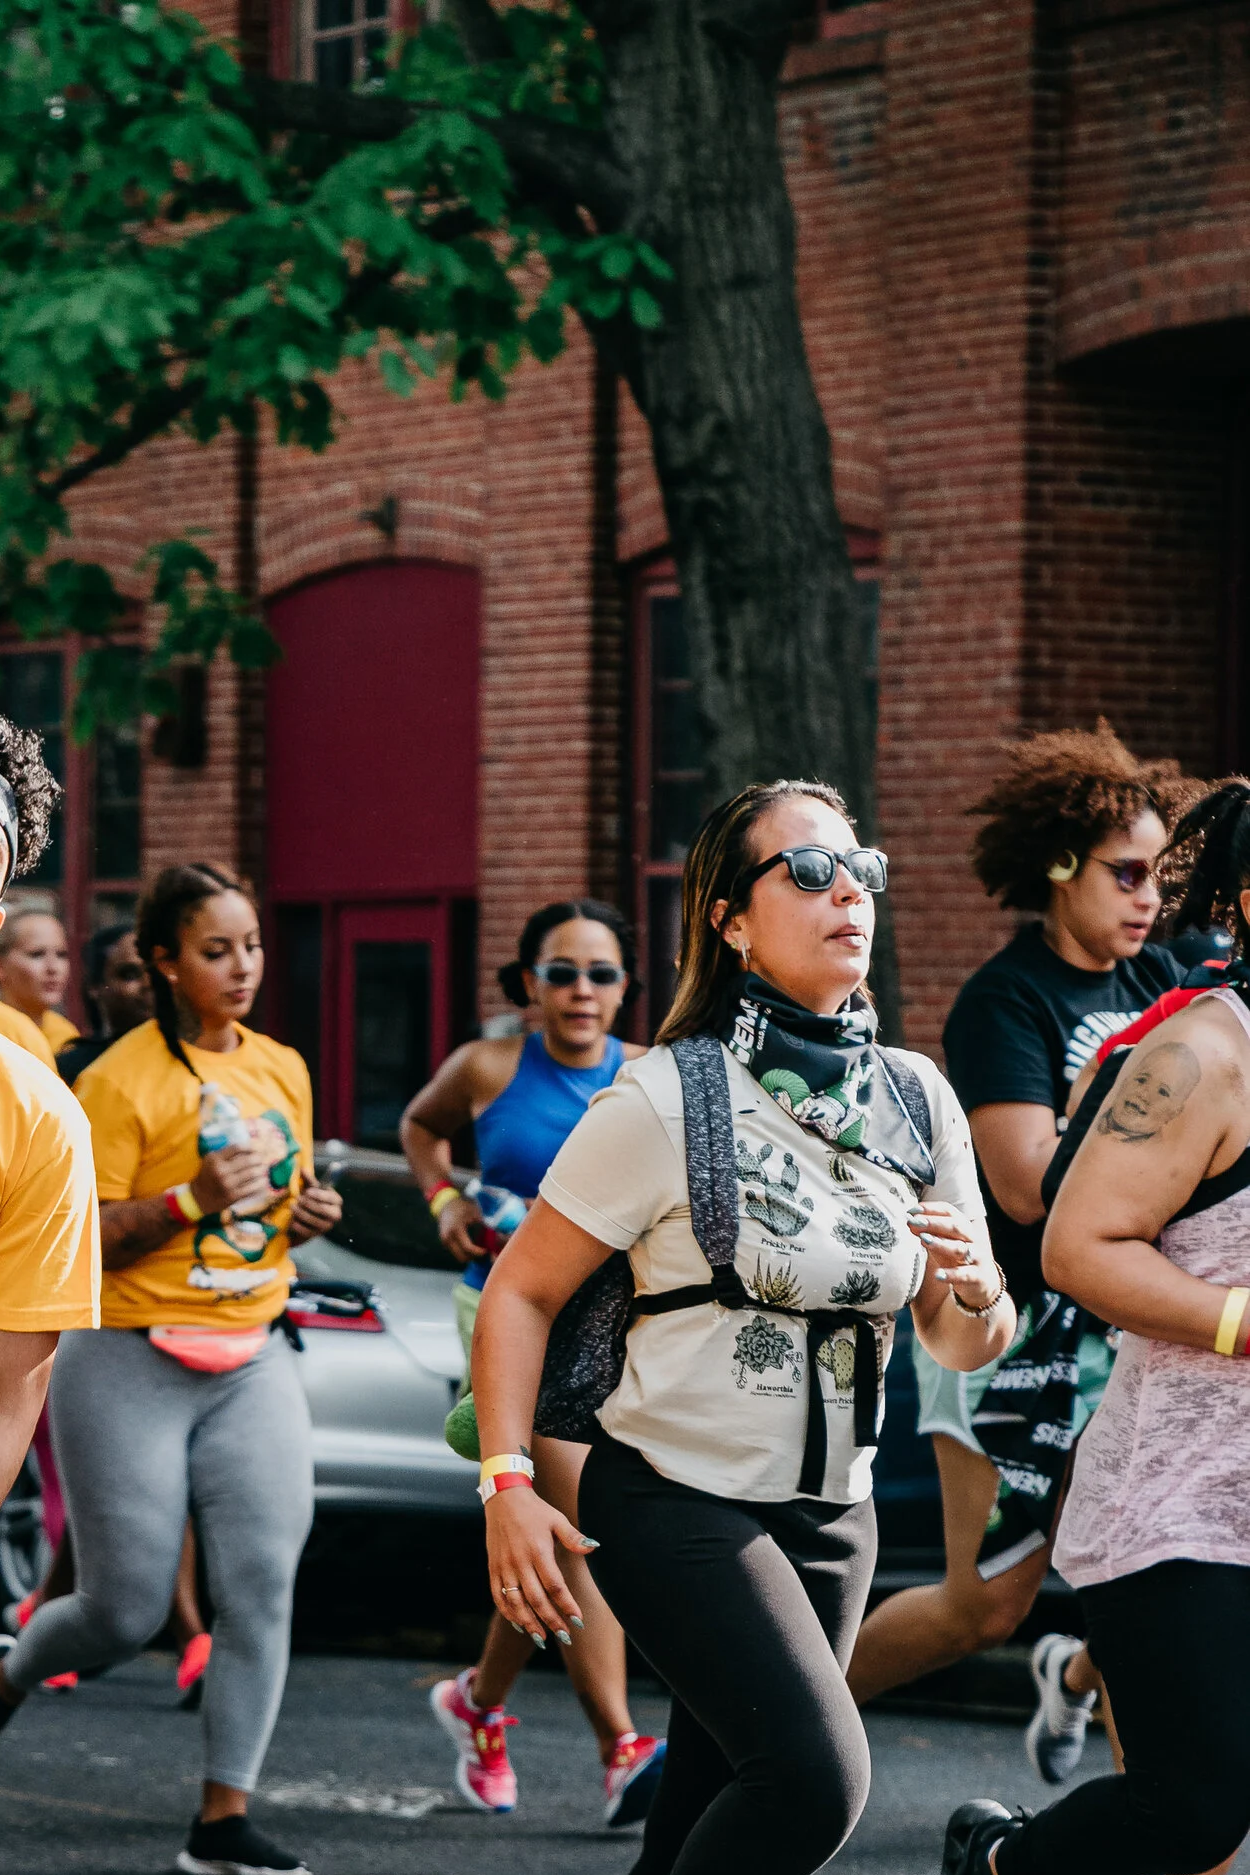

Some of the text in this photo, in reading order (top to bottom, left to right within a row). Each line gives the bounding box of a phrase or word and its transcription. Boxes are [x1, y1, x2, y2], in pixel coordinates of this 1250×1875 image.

[761, 1237, 786, 1251] Prickly
[789, 1243, 806, 1253] Pear
[756, 1383, 794, 1393] Haworthia
